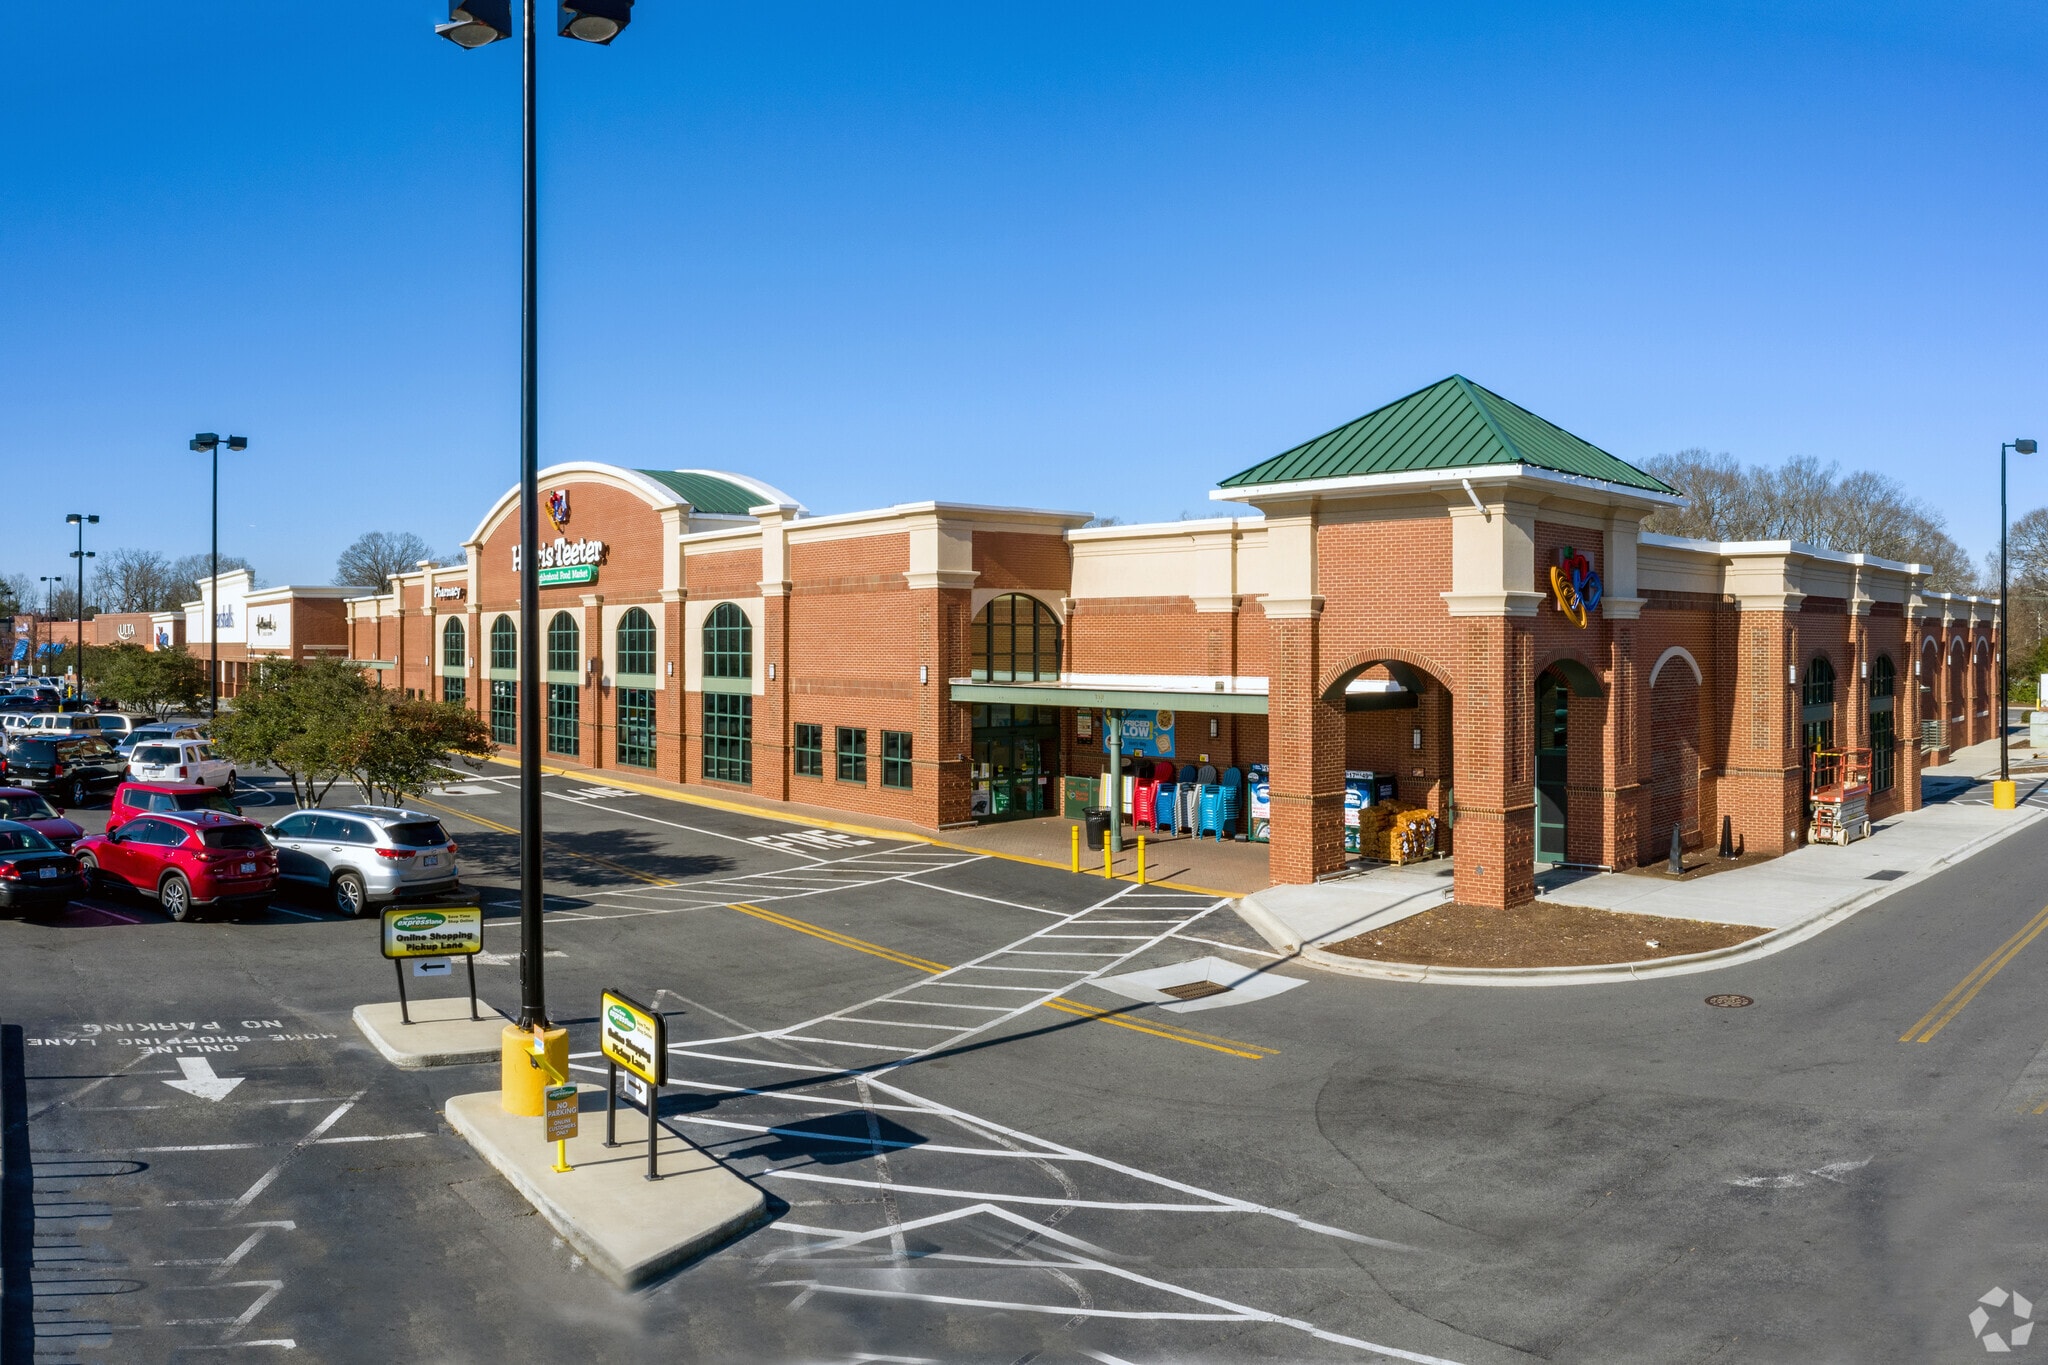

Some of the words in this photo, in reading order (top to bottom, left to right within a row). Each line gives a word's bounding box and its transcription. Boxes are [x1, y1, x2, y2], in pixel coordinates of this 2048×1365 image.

[512, 542, 554, 572] Hris
[554, 538, 602, 566] Teeter
[560, 571, 570, 580] Food
[572, 569, 588, 578] Market
[566, 787, 641, 800] LANE
[747, 830, 875, 853] FIRE
[430, 932, 472, 941] Shopping
[406, 943, 438, 951] Pickup
[82, 1022, 221, 1032] PARKING
[240, 1020, 284, 1028] NO
[118, 1036, 252, 1045] SHOPPING
[142, 1044, 239, 1055] ONLINE
[632, 1055, 645, 1071] Lane
[548, 1106, 577, 1117] PARKING
[549, 1123, 576, 1132] CUSTOMERS
